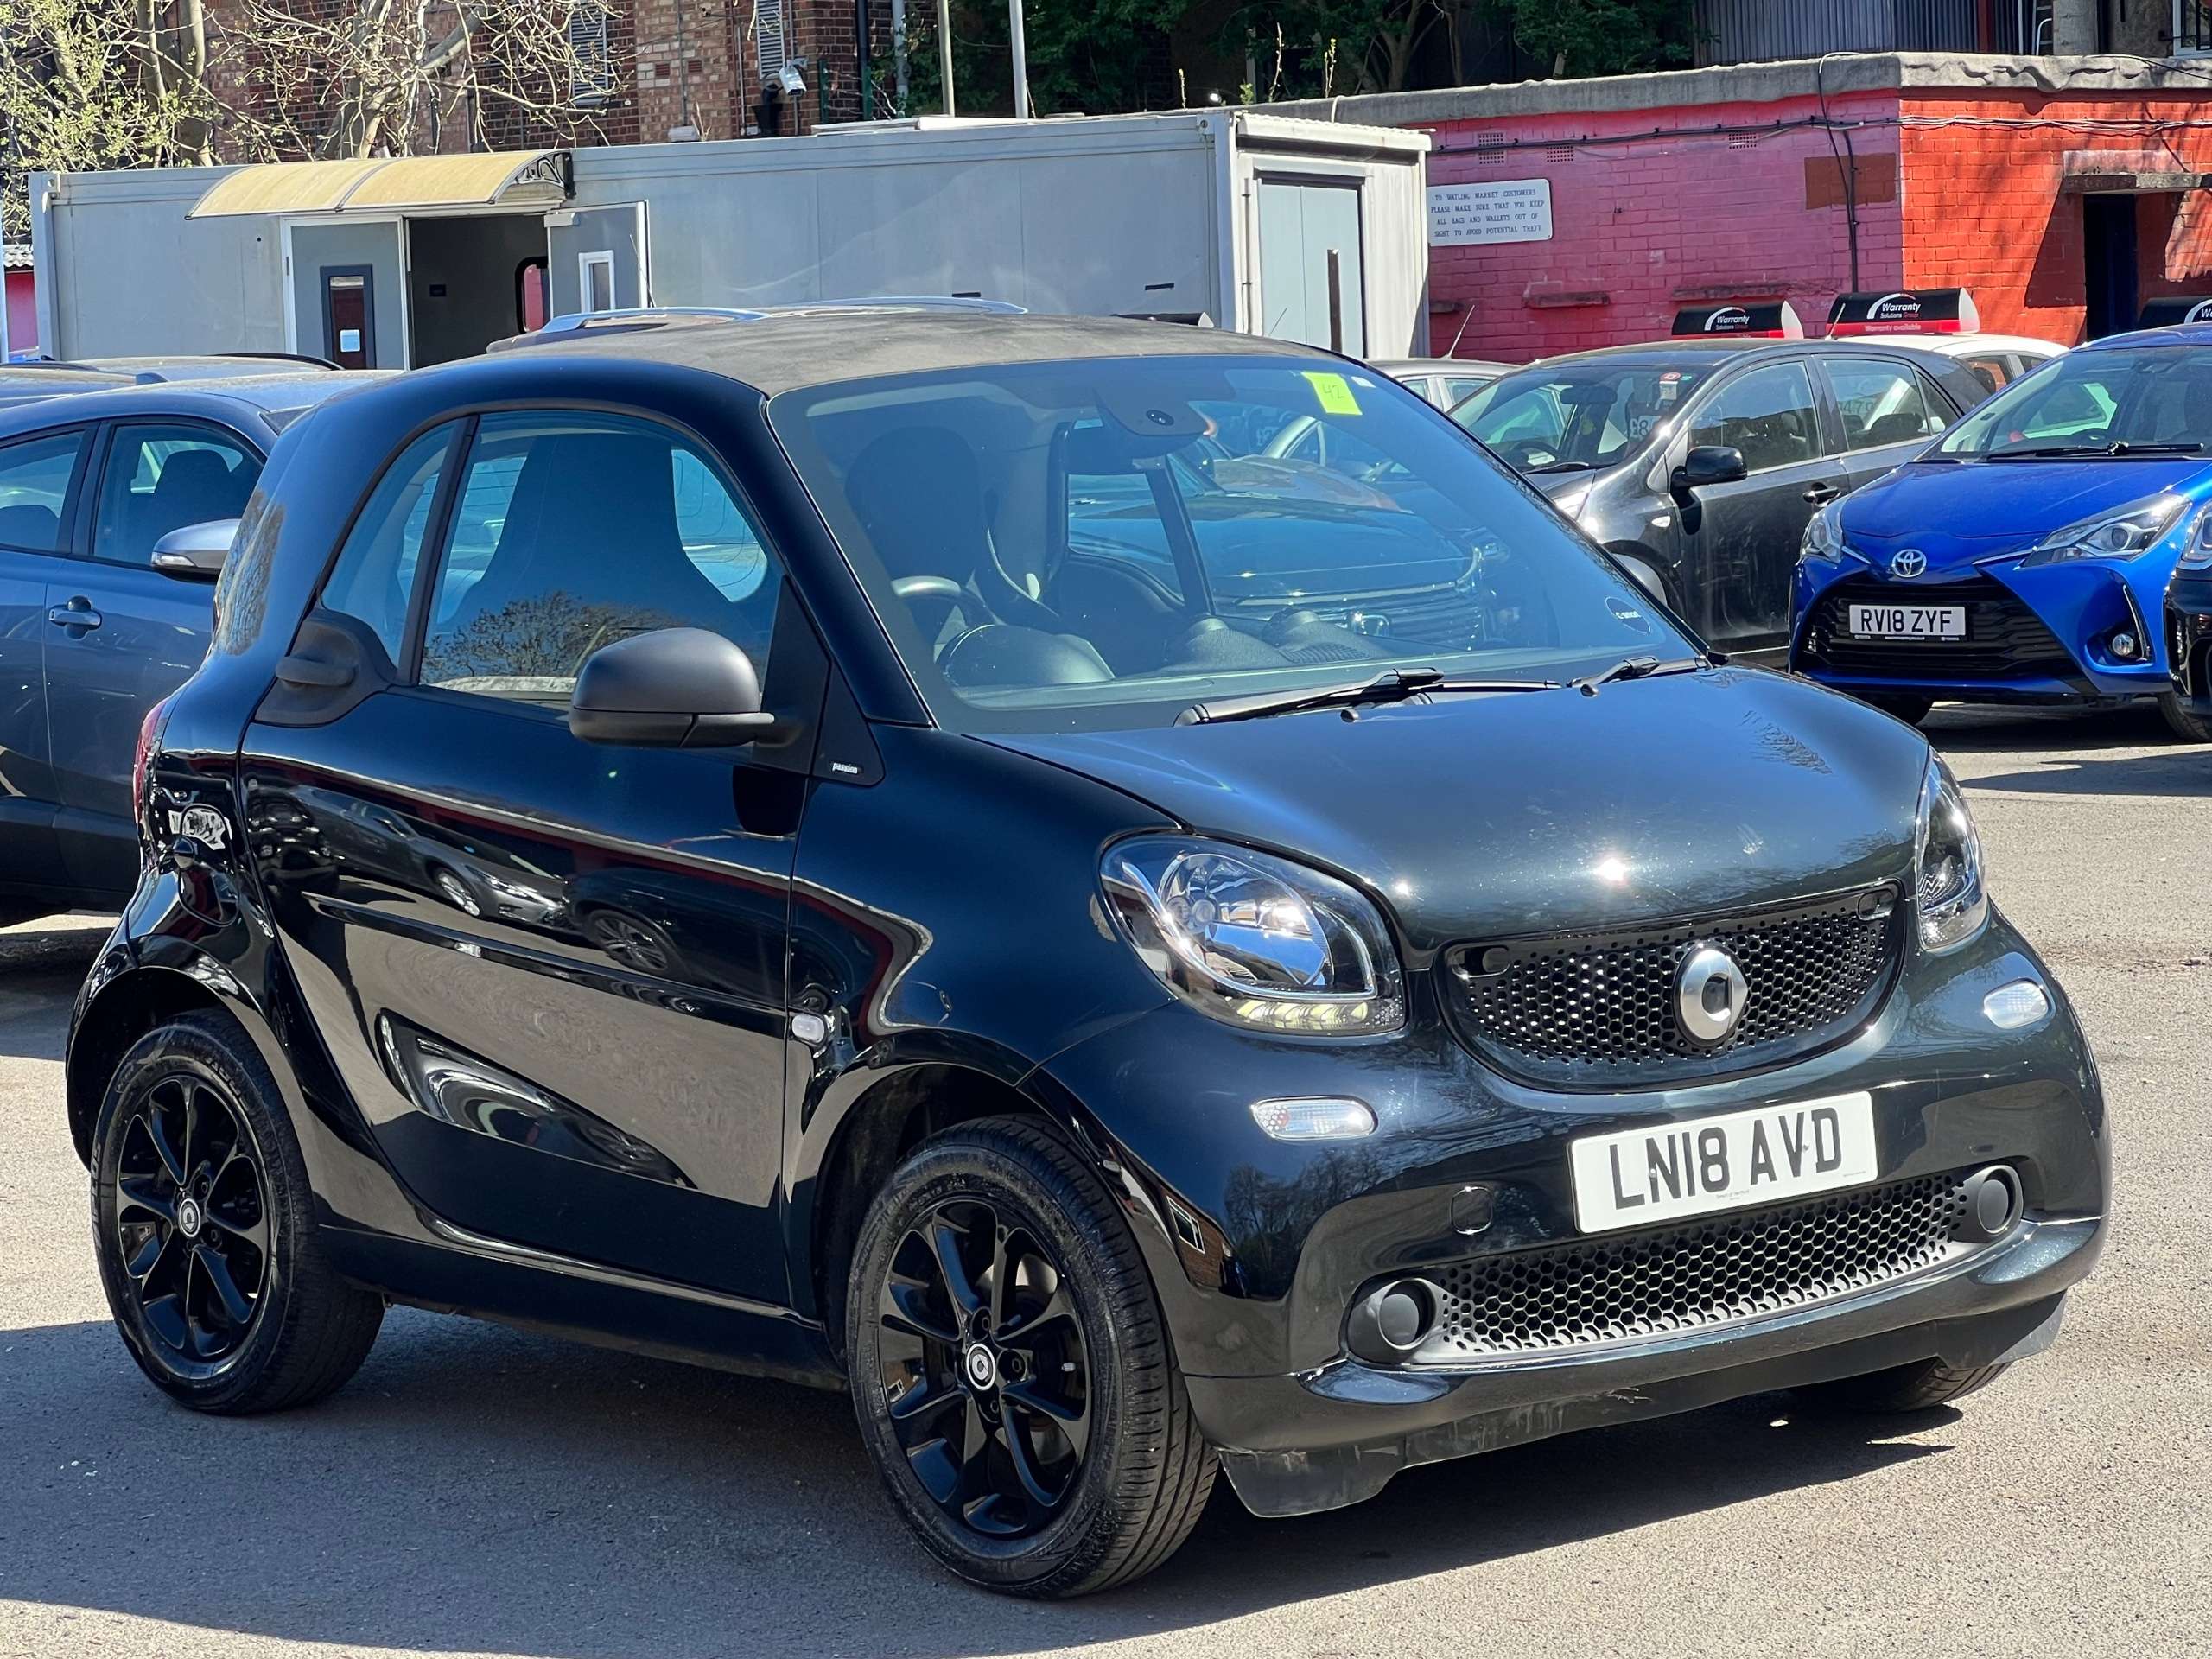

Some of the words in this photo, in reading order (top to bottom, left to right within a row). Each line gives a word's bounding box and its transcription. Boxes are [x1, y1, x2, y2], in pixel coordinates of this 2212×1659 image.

[1882, 302, 1921, 314] Warranty
[1717, 315, 1750, 325] Warranty
[1860, 608, 1904, 632] RV18
[1911, 610, 1952, 632] ZYF
[1609, 1127, 1731, 1210] LN18
[1750, 1107, 1843, 1186] AVD
